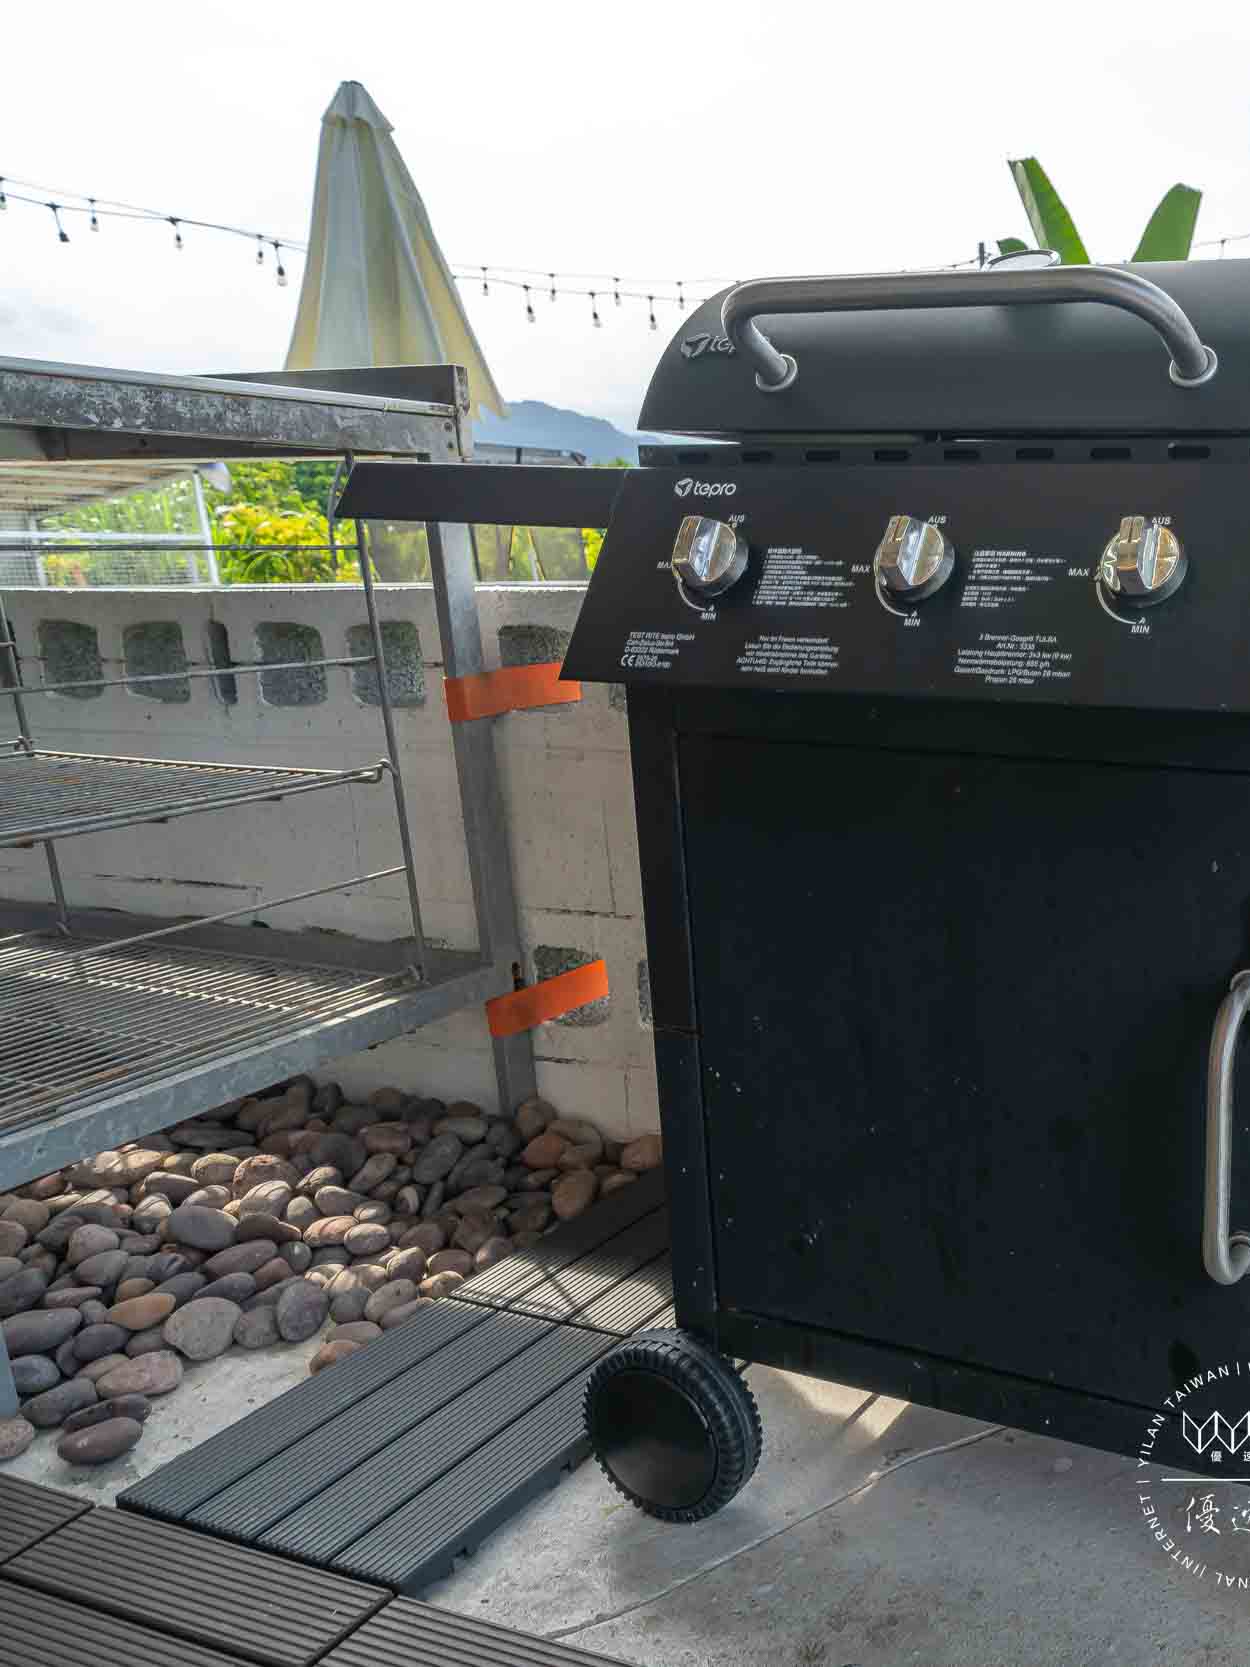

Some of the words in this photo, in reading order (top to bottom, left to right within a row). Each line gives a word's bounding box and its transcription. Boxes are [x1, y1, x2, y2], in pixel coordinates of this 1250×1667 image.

[693, 481, 737, 497] tepro
[728, 514, 745, 522] AUS
[928, 516, 947, 525] AUS
[1152, 517, 1171, 526] AUS
[851, 564, 871, 573] MAX
[1068, 568, 1090, 577] MAX
[701, 612, 717, 621] MIN
[904, 618, 921, 627] MIN
[1131, 625, 1151, 634] MIN
